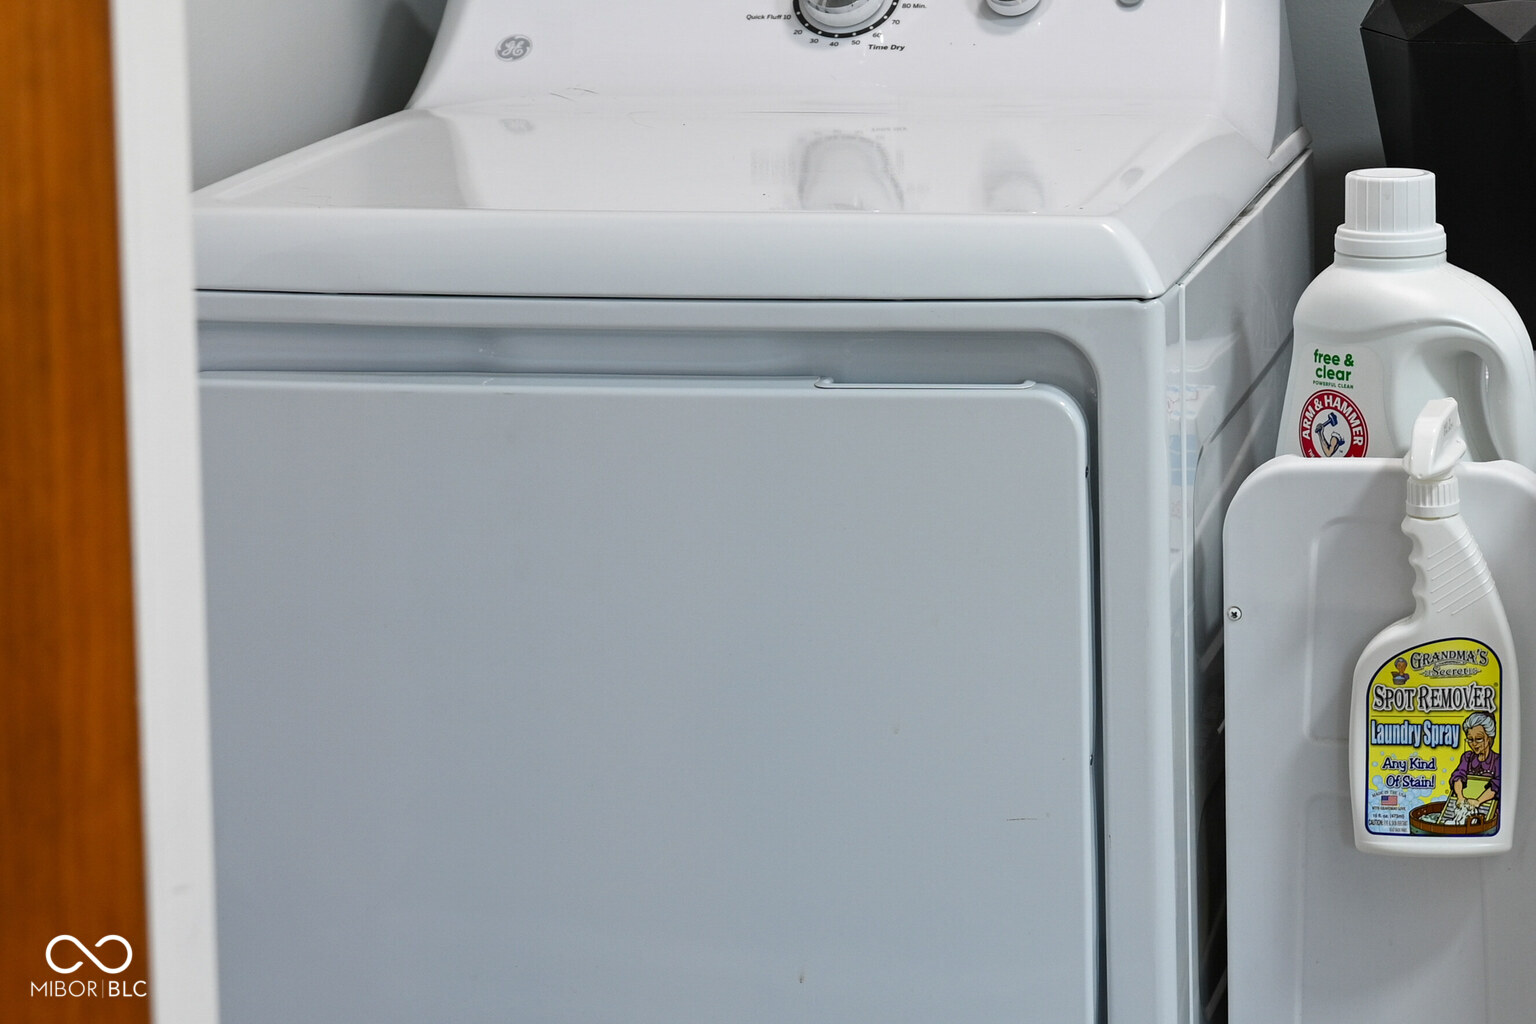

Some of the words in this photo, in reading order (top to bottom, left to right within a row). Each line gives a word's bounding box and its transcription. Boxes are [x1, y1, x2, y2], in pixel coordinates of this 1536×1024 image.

[890, 44, 905, 52] Dry
[1314, 349, 1341, 365] free
[1343, 353, 1354, 367] &
[1315, 365, 1352, 381] clear
[1312, 380, 1337, 388] POWERFUL
[1302, 406, 1317, 440] ARM
[1314, 398, 1324, 411] &
[1324, 395, 1364, 446] HAMMER
[1410, 649, 1489, 671] GRANDMA'S
[1432, 665, 1468, 676] Secret
[1373, 684, 1415, 710] SPOT
[1418, 682, 1496, 712] REMOVER
[1371, 719, 1421, 748] Laundry
[1422, 719, 1460, 749] Spray
[1382, 757, 1407, 772] Any
[1409, 757, 1436, 770] Kind
[1386, 775, 1400, 788] Of
[1402, 775, 1436, 788] Stain!
